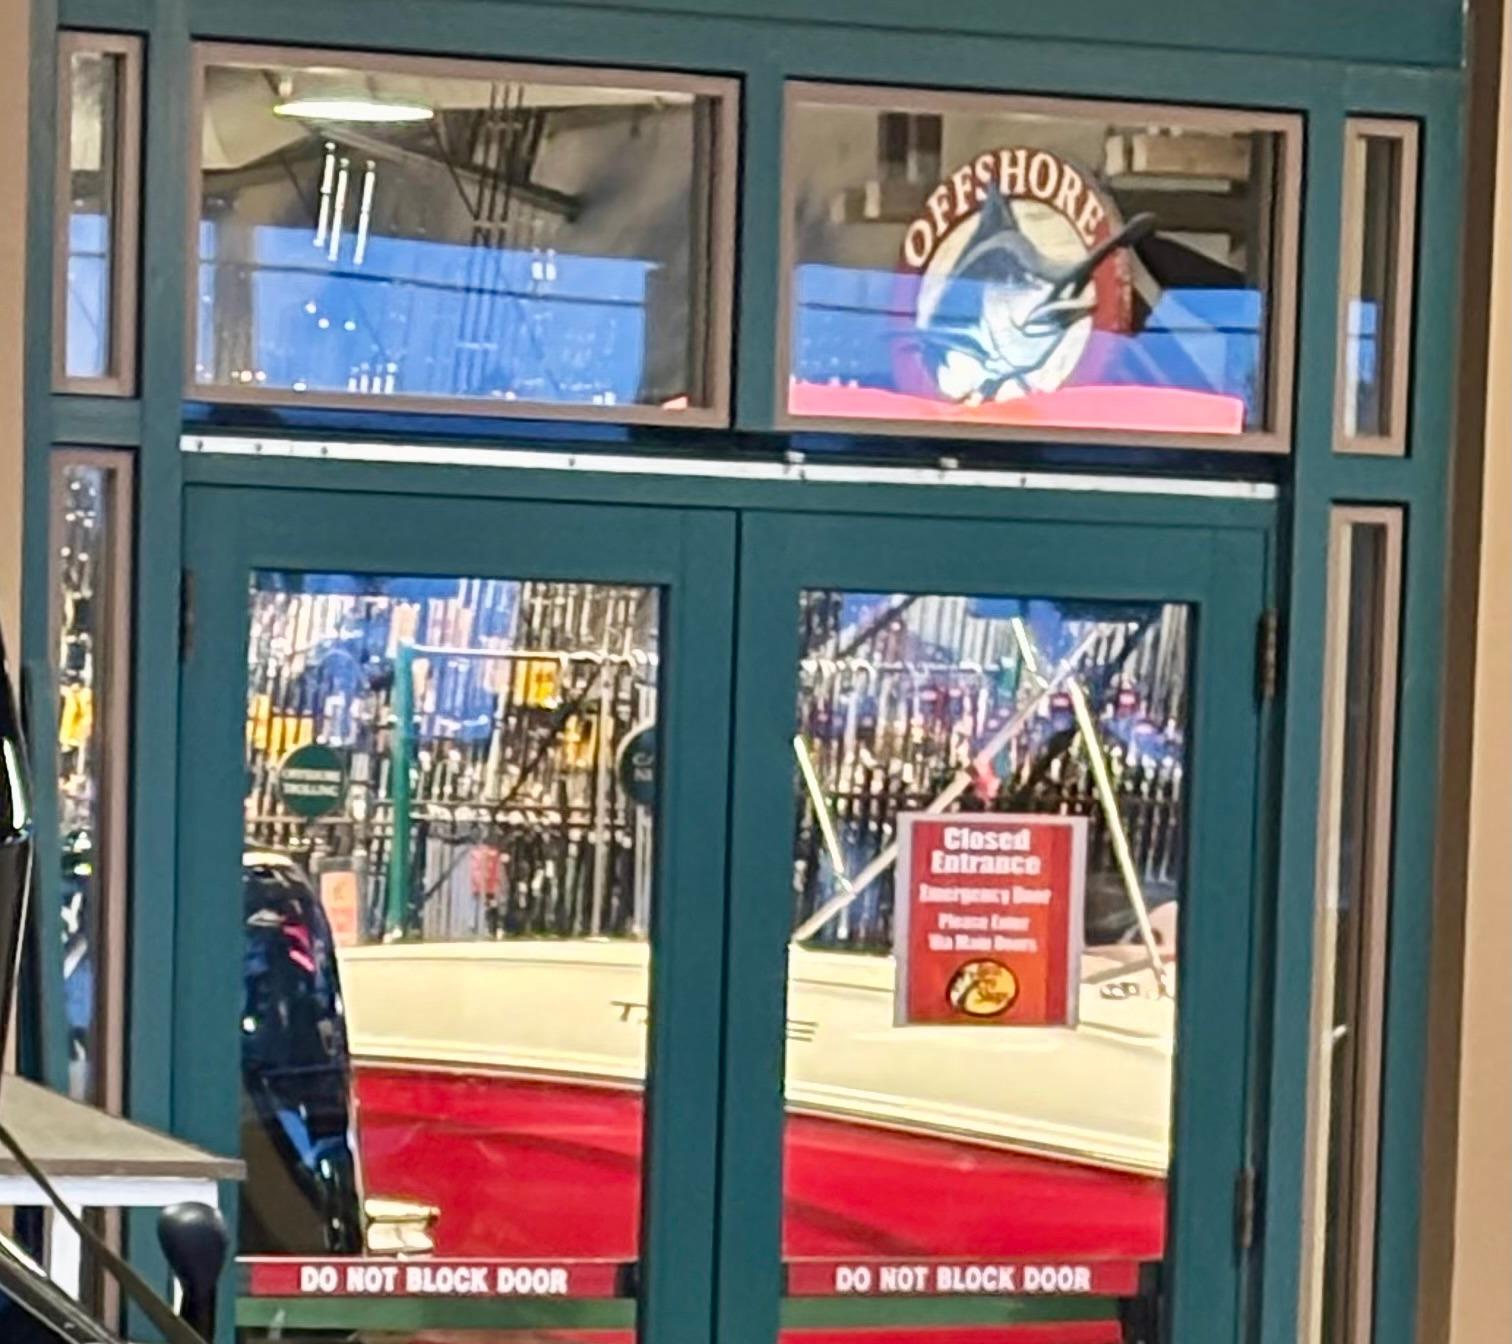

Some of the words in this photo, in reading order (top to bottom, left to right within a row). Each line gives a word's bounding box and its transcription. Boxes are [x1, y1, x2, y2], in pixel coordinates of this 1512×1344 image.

[904, 149, 1106, 268] OFFSHORE
[943, 826, 1032, 852] Closed
[930, 850, 1042, 876] Entrance
[300, 1265, 338, 1293] DO
[346, 1265, 398, 1293] NOT
[406, 1265, 489, 1293] BLOCK
[496, 1267, 569, 1294] DOOR
[835, 1264, 872, 1292] DO
[879, 1264, 928, 1292] NOT
[936, 1264, 1016, 1292] BLOCK
[1023, 1265, 1091, 1293] DOOR
